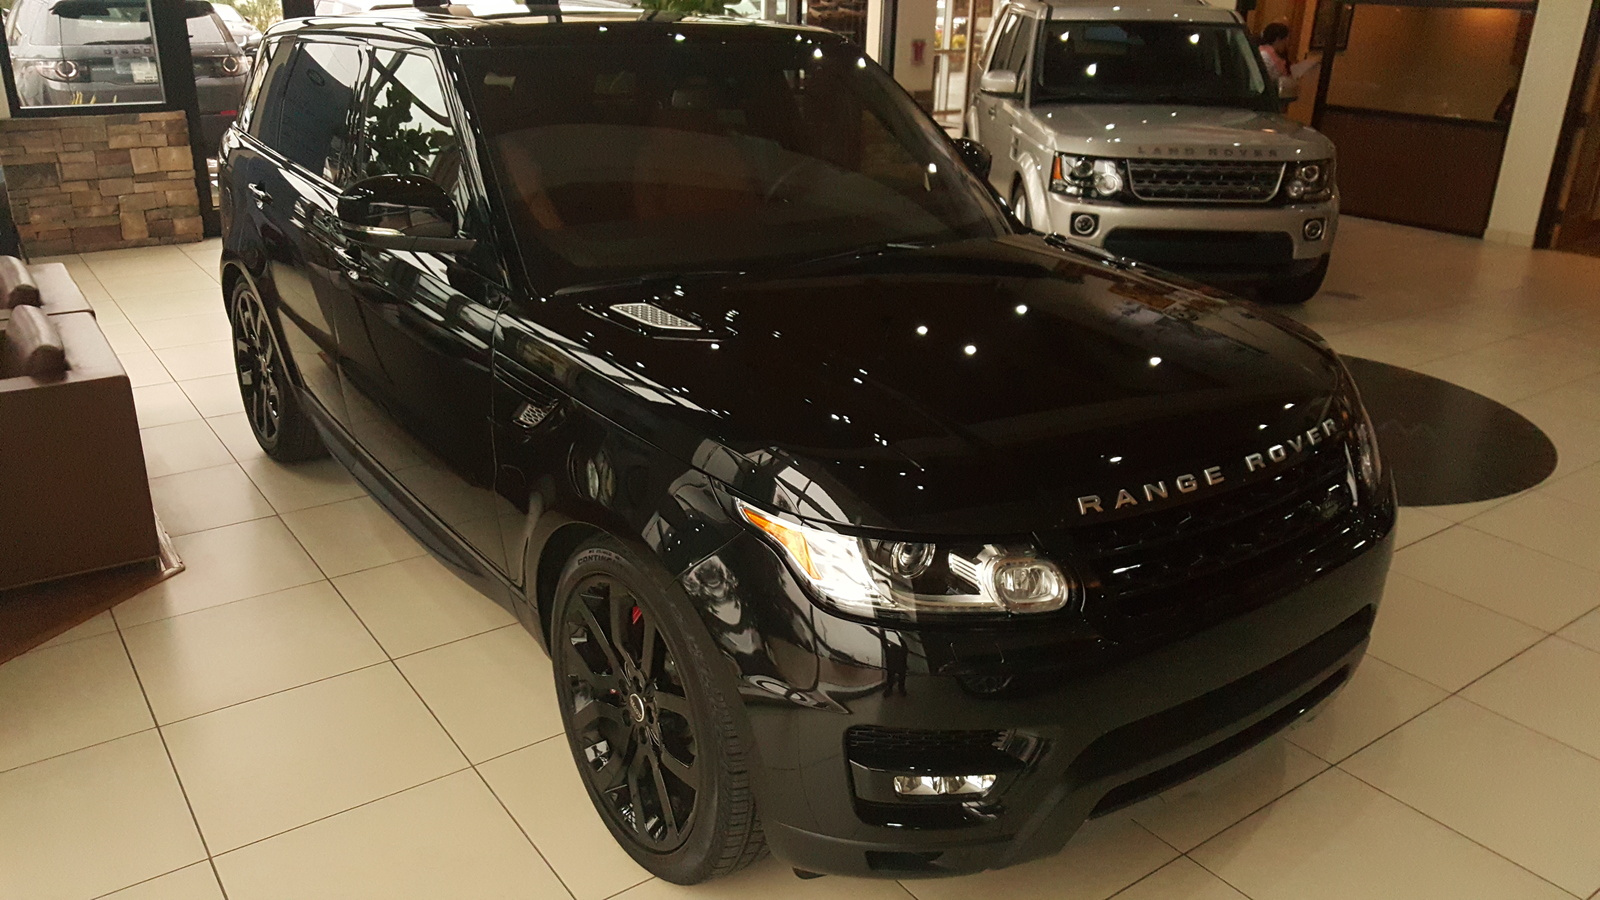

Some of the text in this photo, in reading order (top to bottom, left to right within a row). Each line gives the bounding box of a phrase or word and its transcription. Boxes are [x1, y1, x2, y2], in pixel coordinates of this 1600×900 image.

[1138, 146, 1278, 157] LAND ROVER
[1077, 418, 1338, 515] RANGE ROVER
